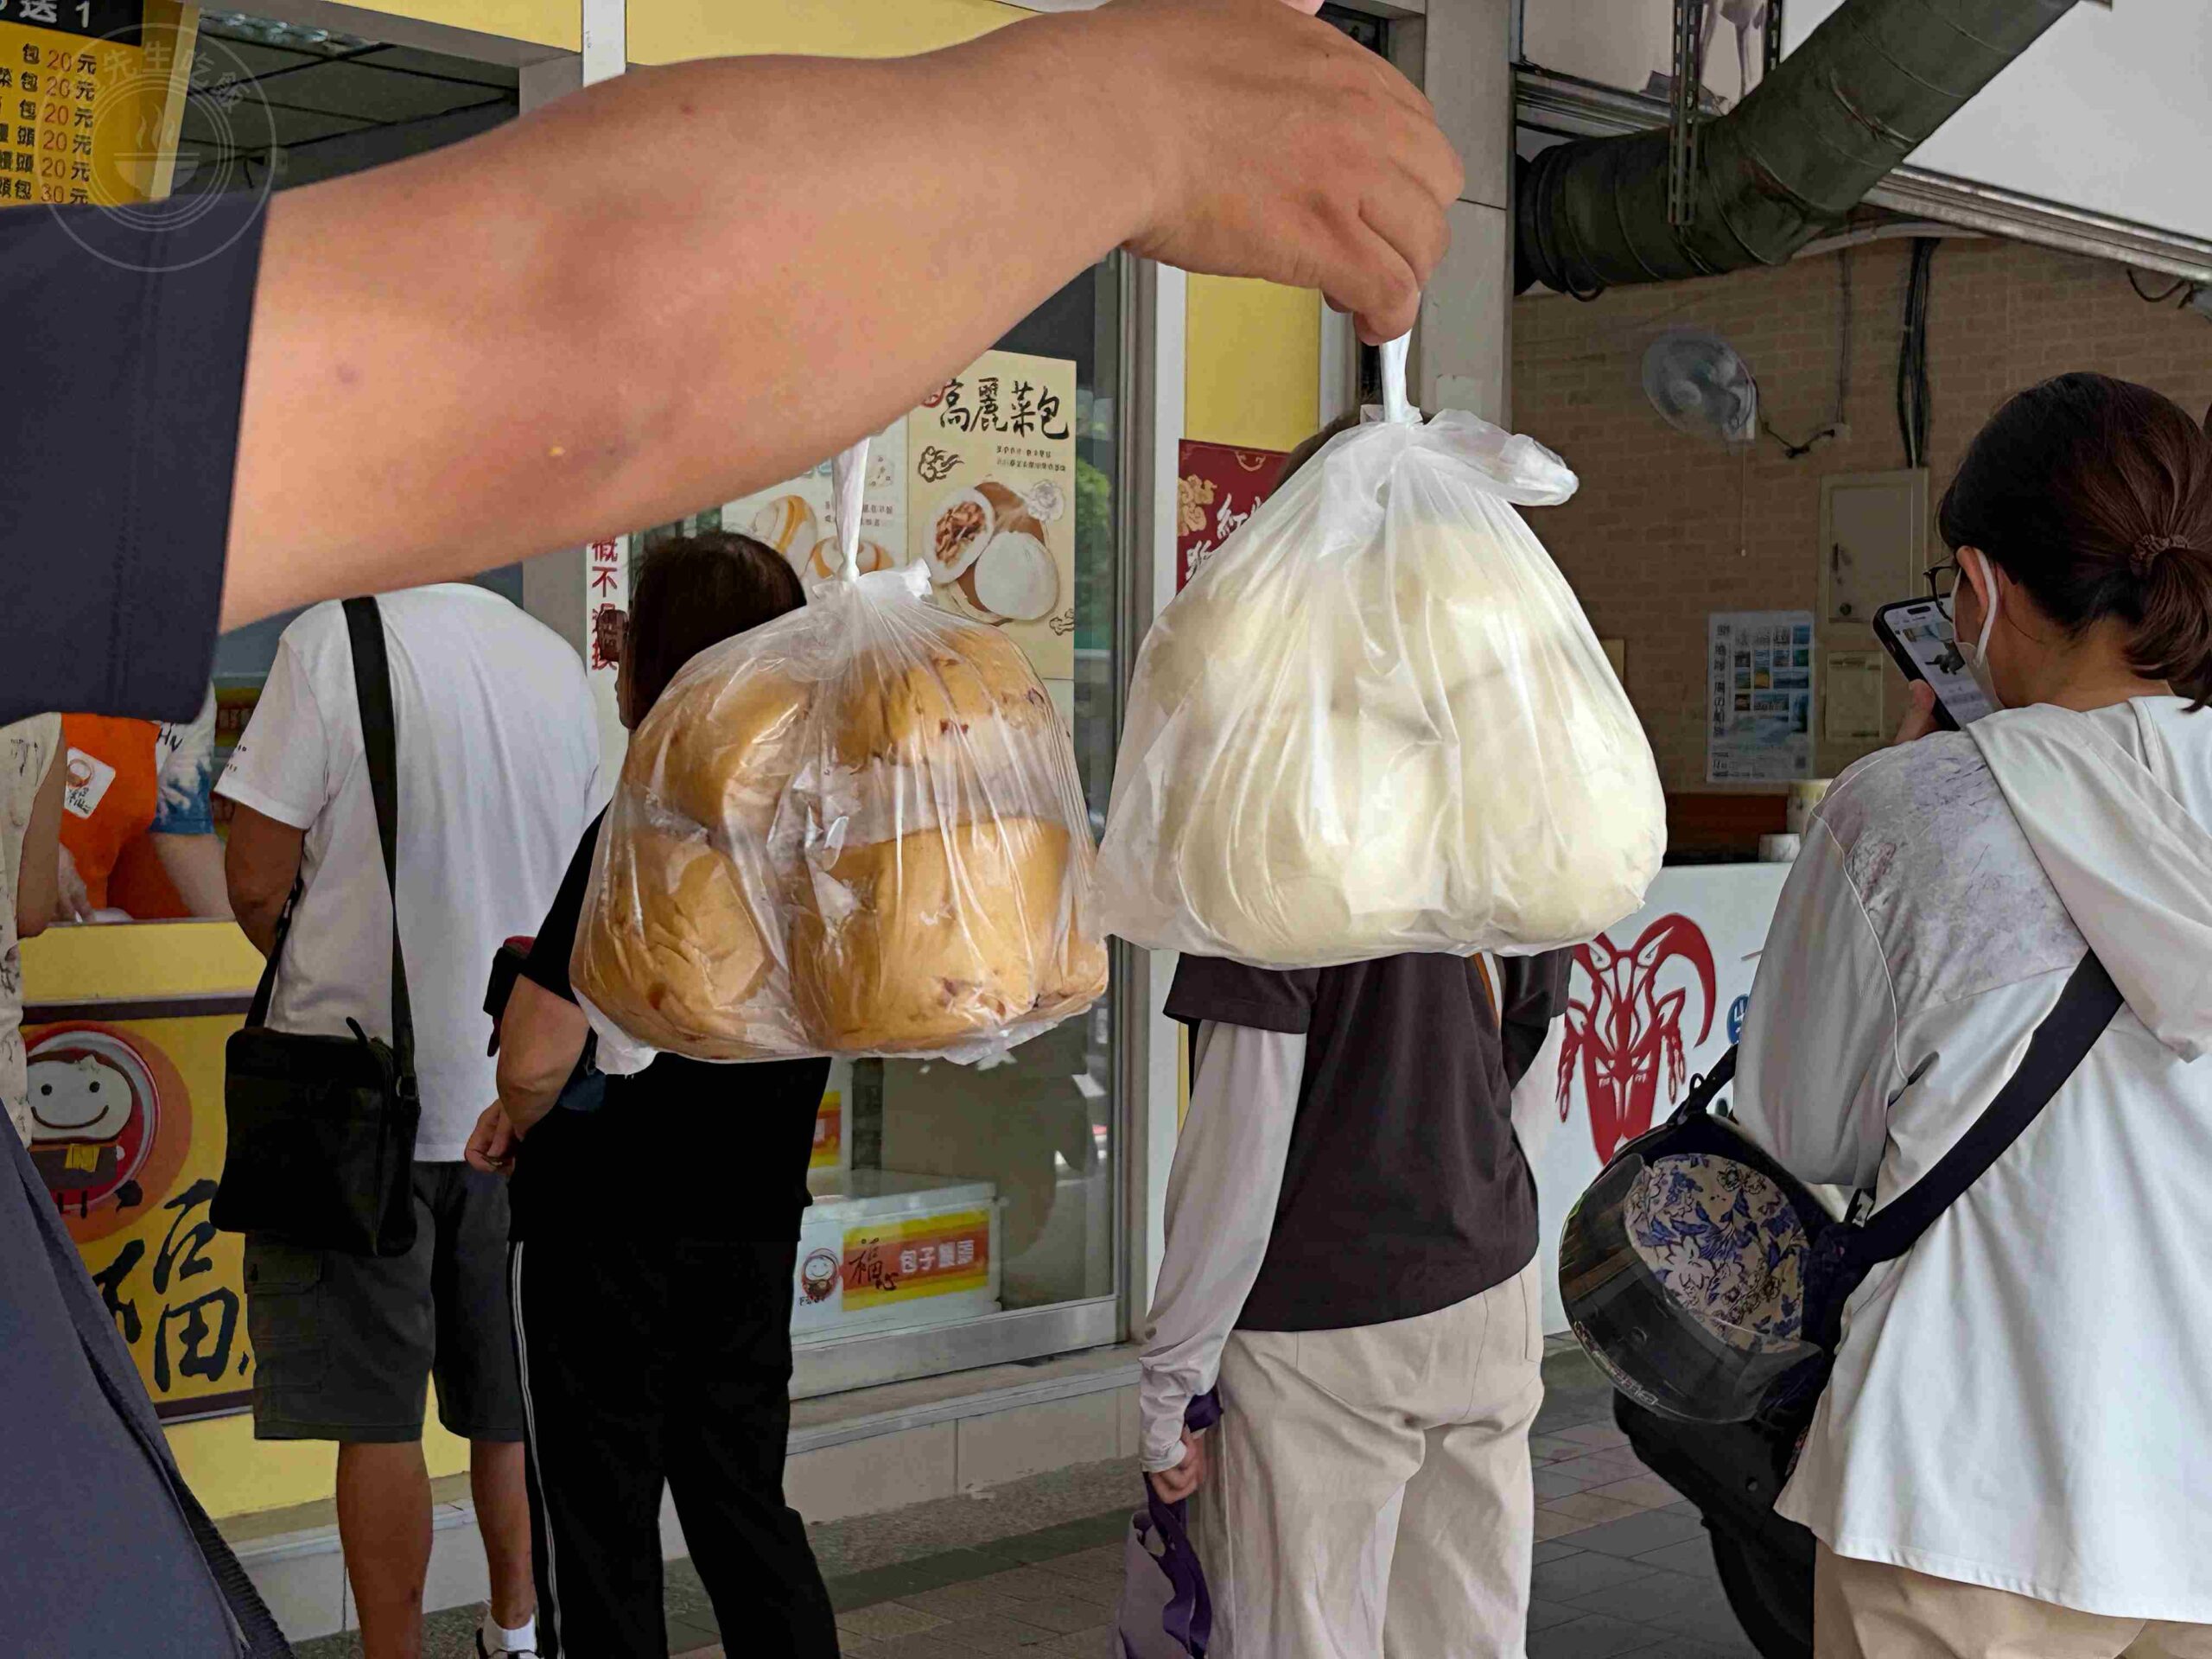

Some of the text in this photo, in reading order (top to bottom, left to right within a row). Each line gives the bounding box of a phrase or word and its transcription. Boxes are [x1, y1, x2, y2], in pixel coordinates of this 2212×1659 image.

[940, 377, 1070, 440] 高麗菜包
[92, 1178, 251, 1393] 福
